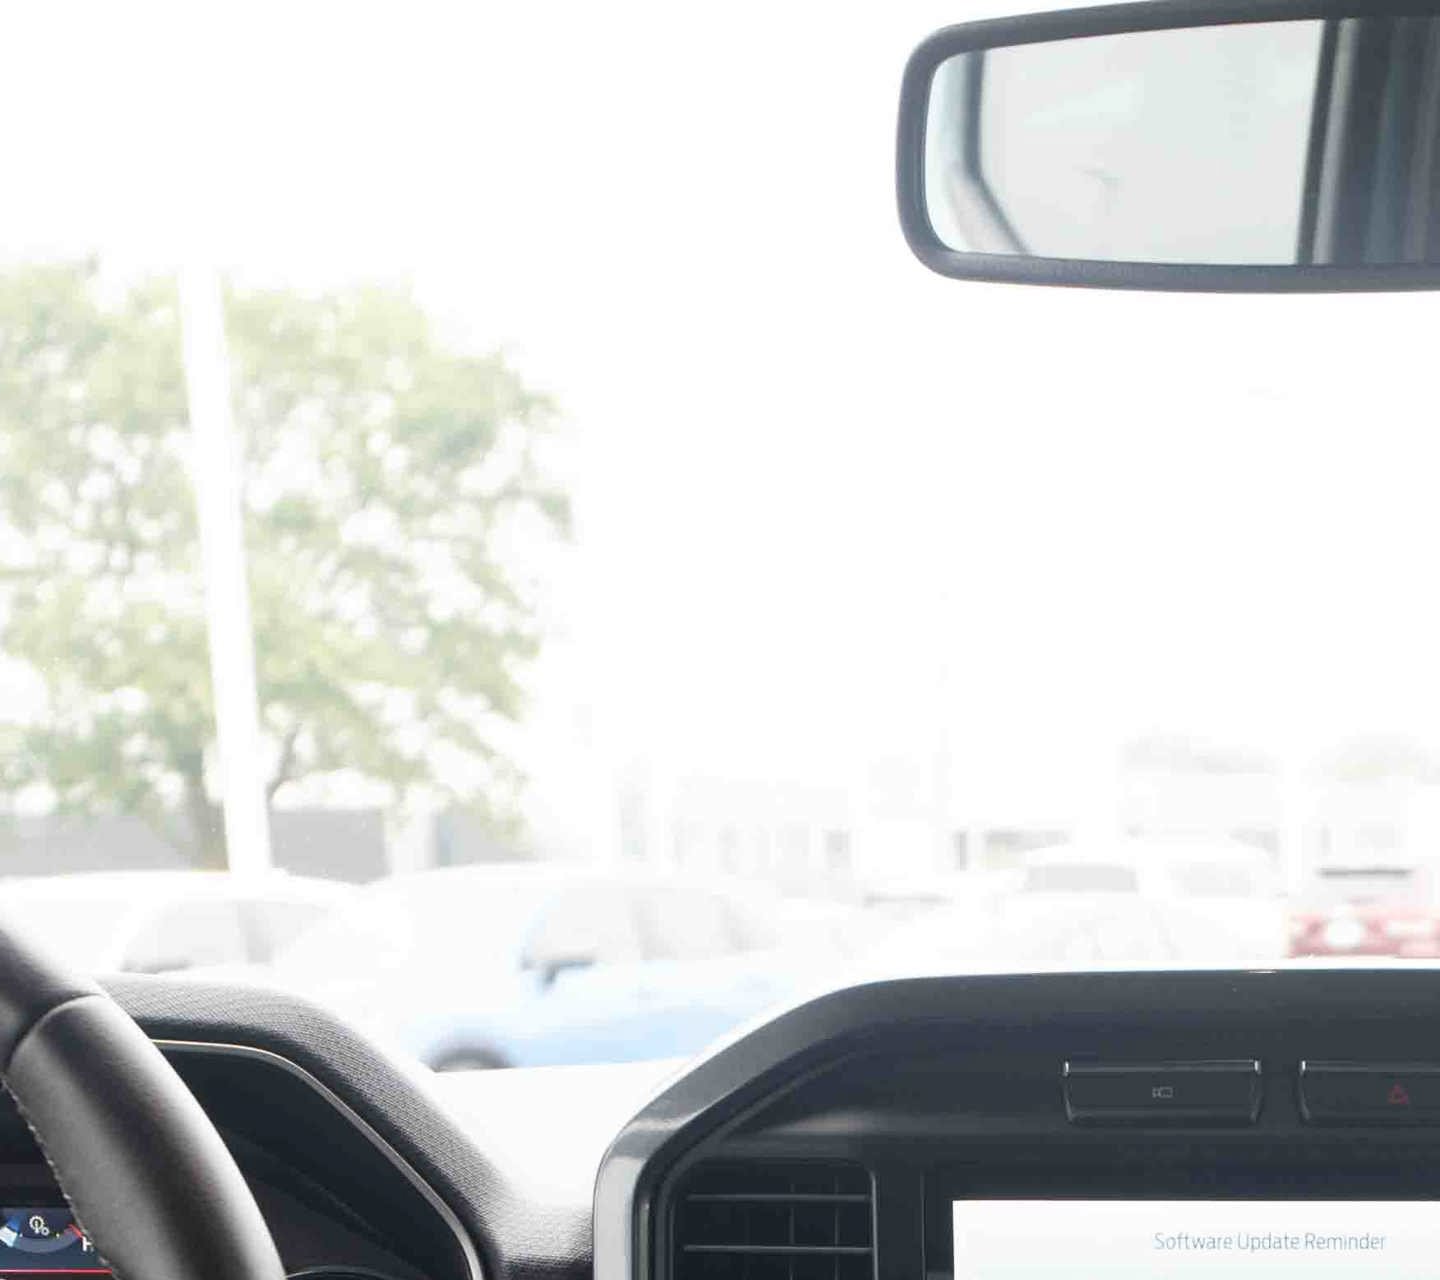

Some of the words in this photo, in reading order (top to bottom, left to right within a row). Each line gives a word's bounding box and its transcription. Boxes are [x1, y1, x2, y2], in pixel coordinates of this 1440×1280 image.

[1154, 1232, 1233, 1250] Software
[1237, 1231, 1300, 1253] Update
[1304, 1232, 1385, 1250] Reminder
